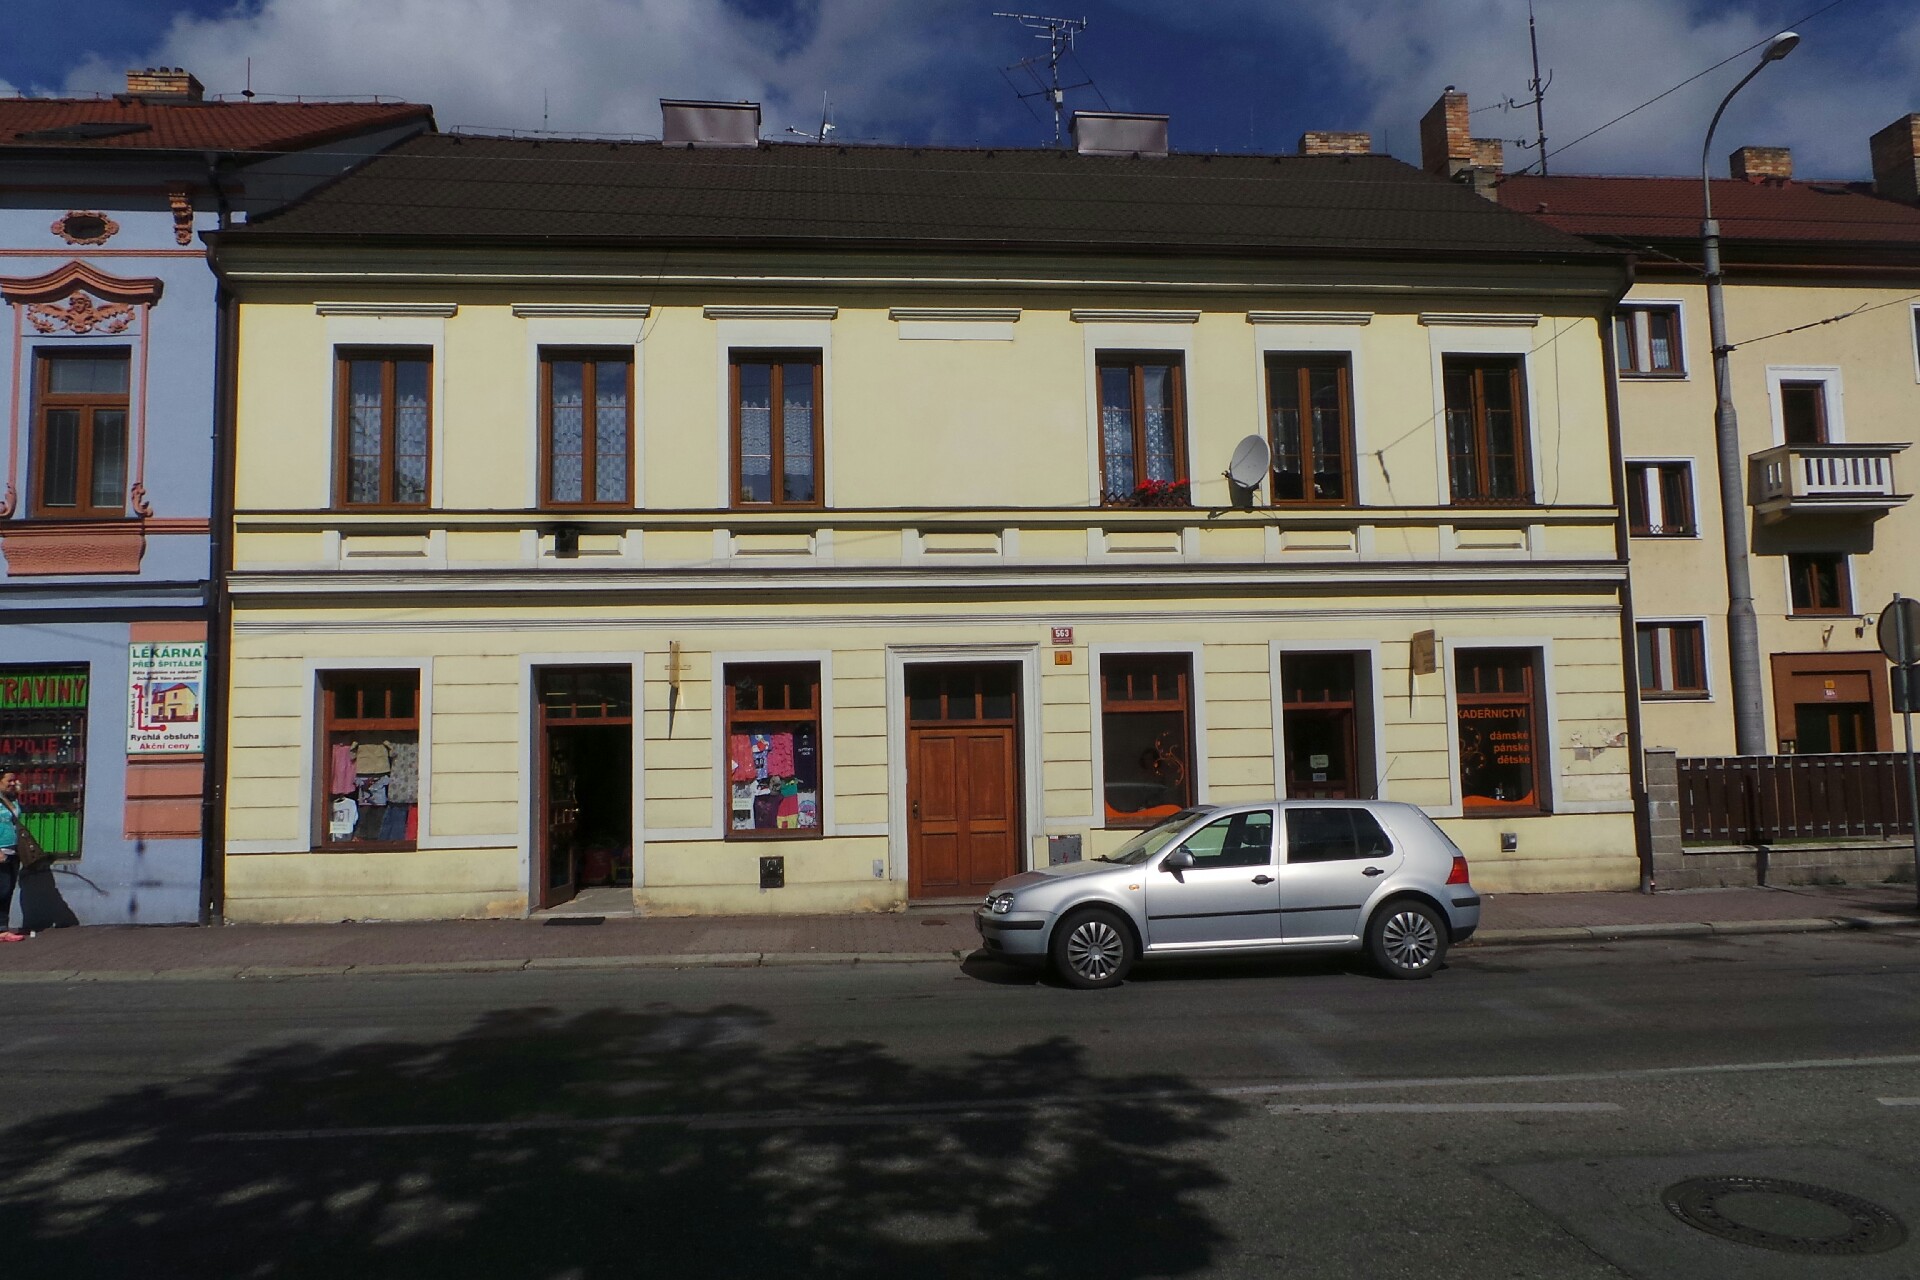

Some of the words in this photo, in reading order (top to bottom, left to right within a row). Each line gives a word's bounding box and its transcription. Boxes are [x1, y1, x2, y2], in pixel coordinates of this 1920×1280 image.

[1055, 629, 1069, 637] 563
[132, 646, 202, 658] LÉKÁRNA
[132, 660, 155, 668] PŘED
[158, 659, 202, 668] ŠPITÁLEM
[131, 734, 161, 742] Rychlá
[163, 733, 200, 741] obsluha
[1489, 731, 1529, 741] dámské
[0, 737, 58, 754] APOJE
[1493, 743, 1530, 754] pánské
[1497, 755, 1531, 764] dětské
